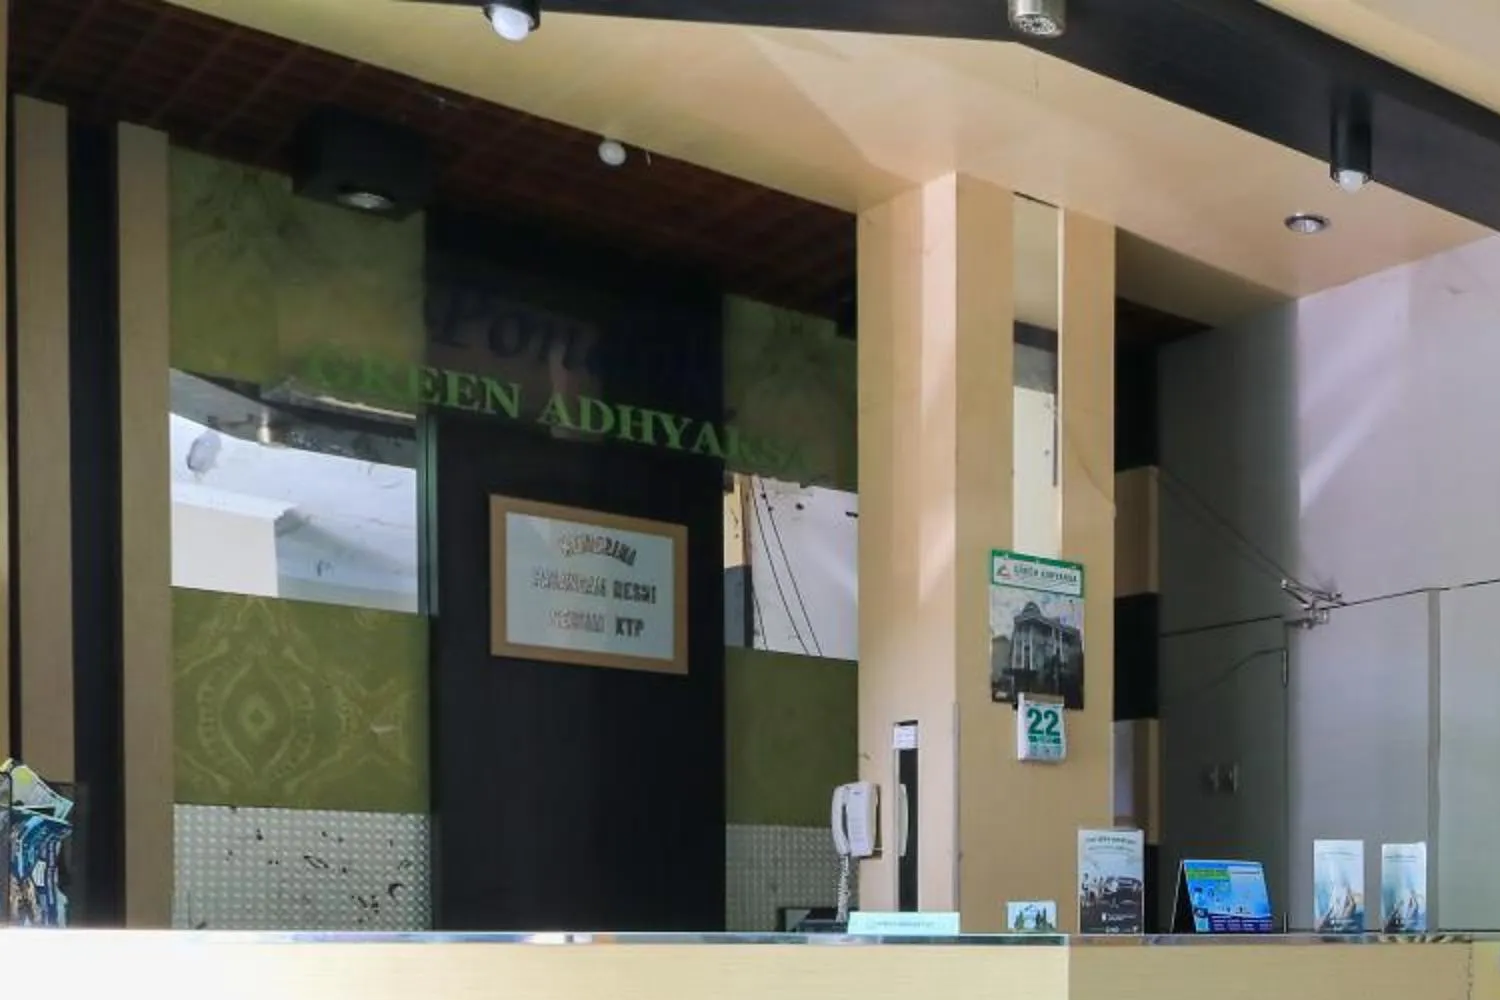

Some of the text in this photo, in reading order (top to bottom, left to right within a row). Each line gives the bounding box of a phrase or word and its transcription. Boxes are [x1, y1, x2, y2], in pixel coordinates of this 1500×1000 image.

[309, 348, 807, 470] GREEN ADHYAKSA
[1027, 709, 1060, 736] 22
